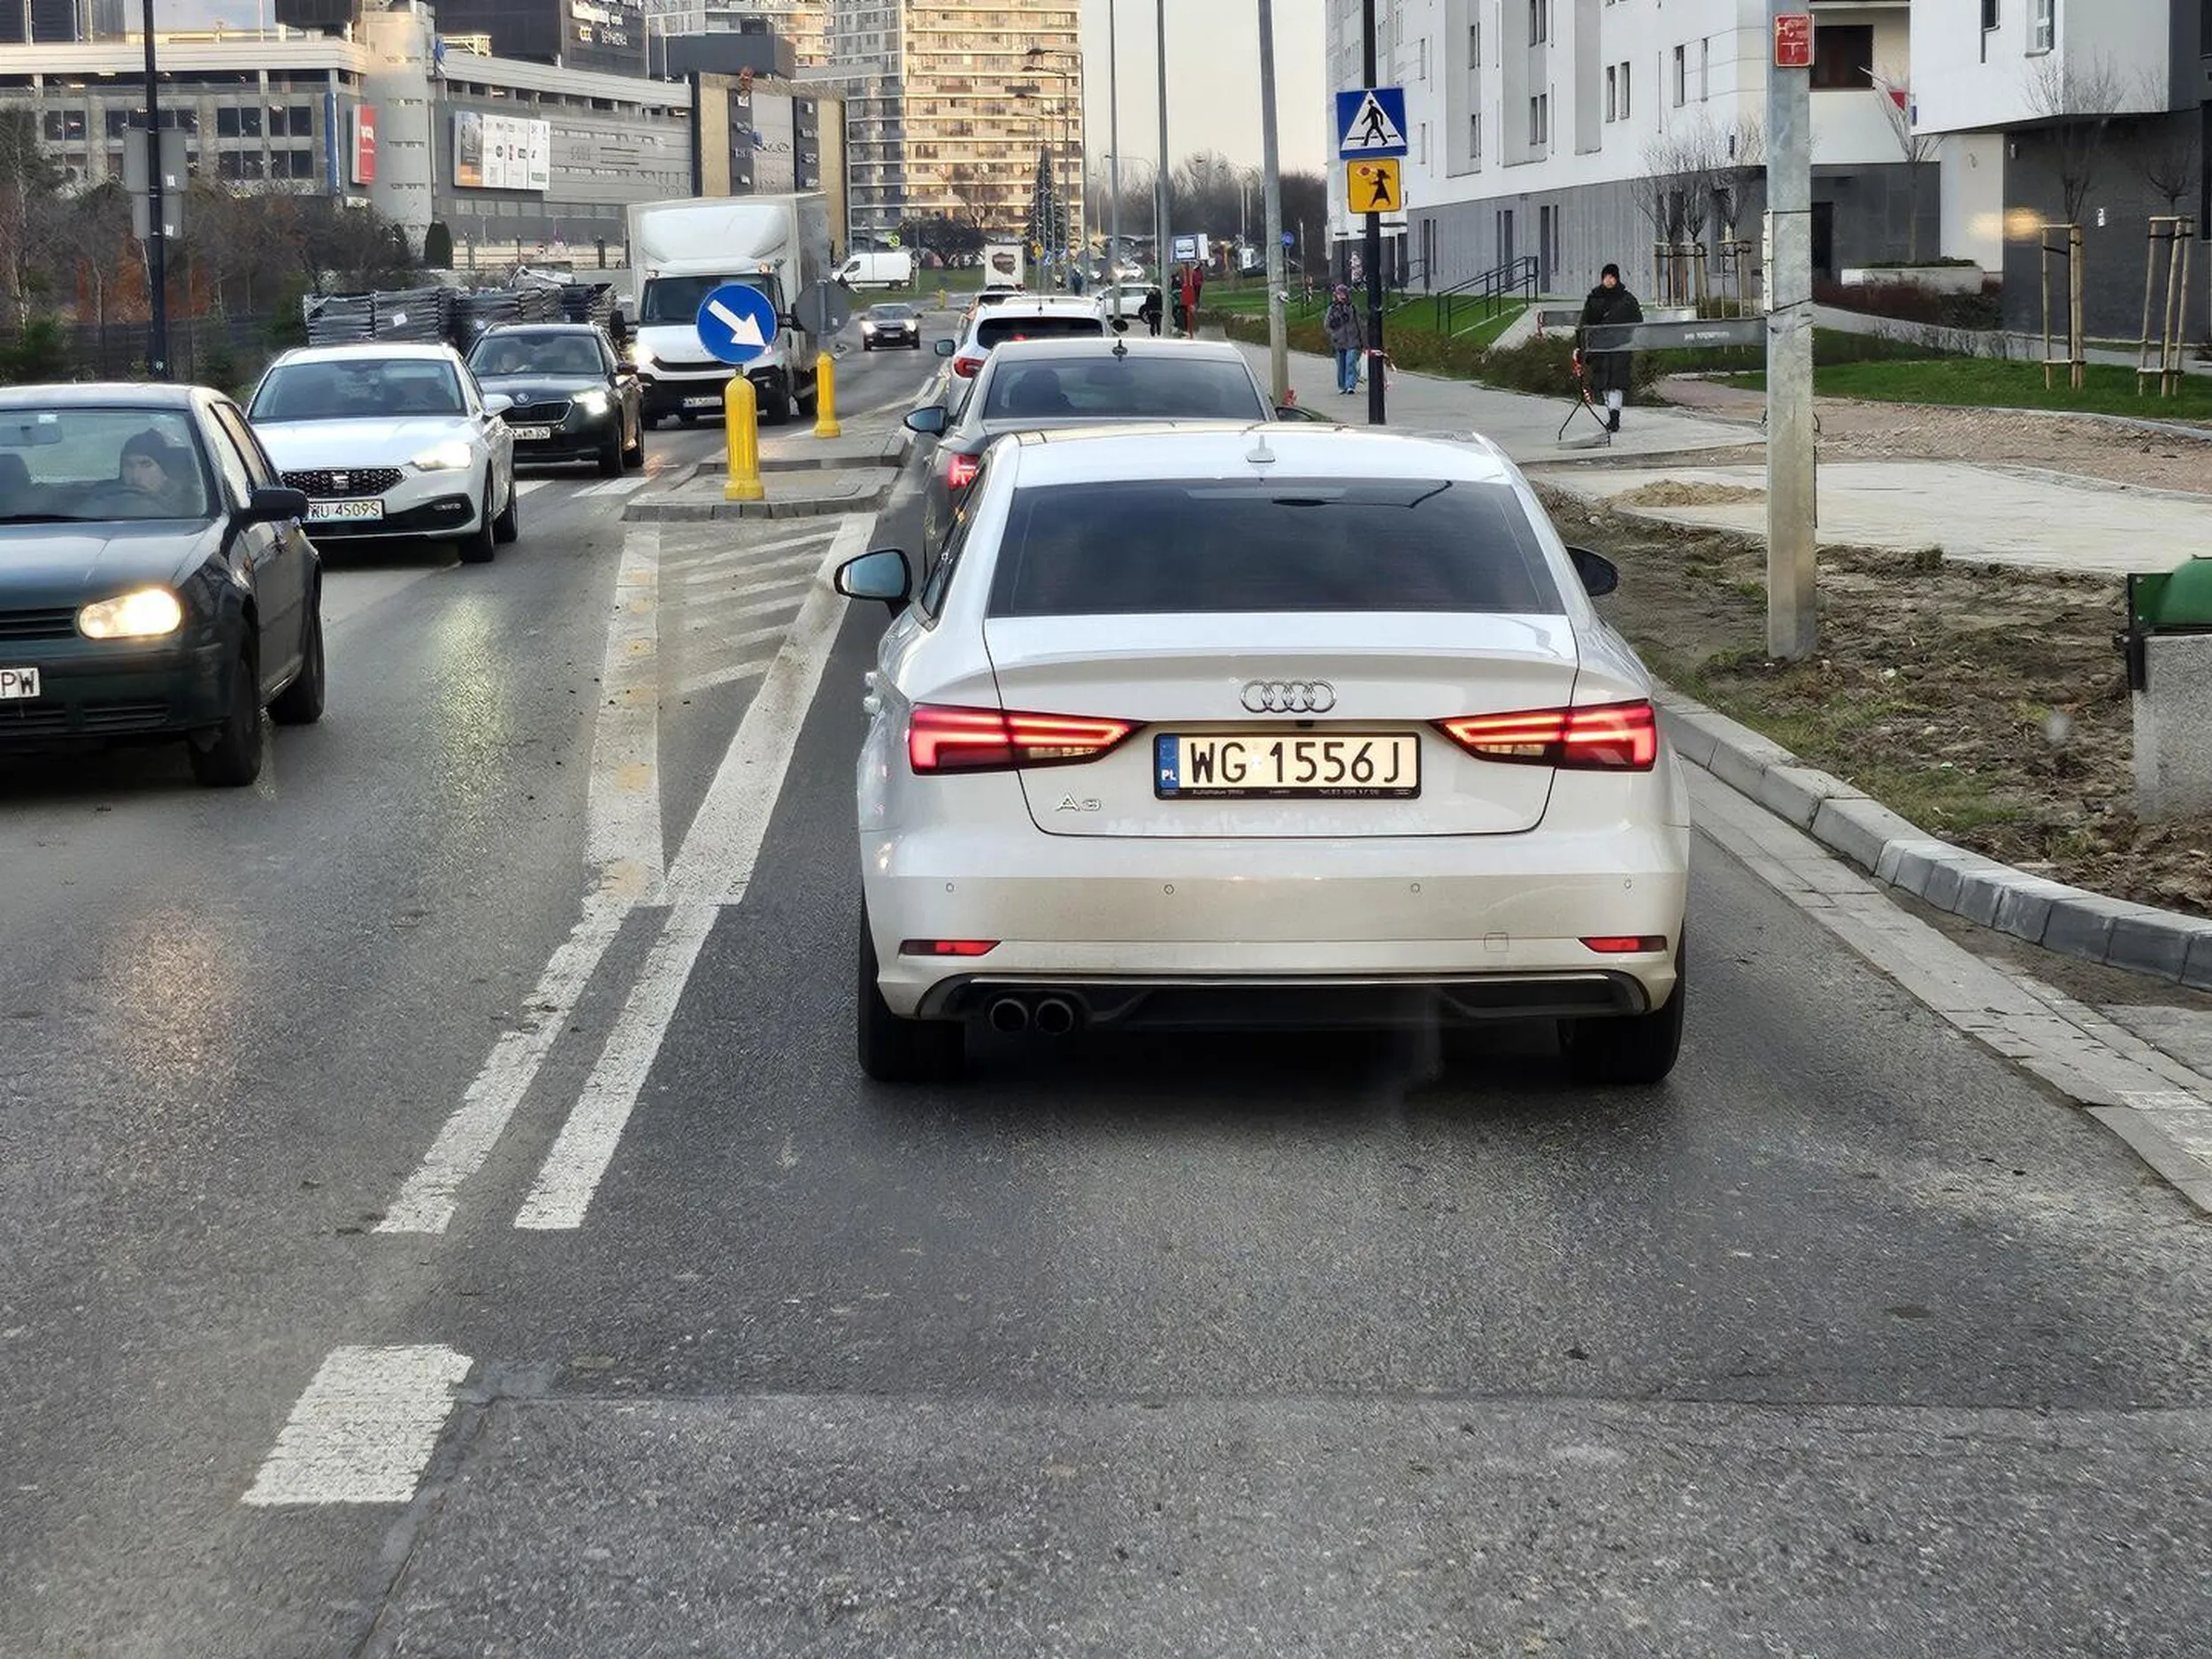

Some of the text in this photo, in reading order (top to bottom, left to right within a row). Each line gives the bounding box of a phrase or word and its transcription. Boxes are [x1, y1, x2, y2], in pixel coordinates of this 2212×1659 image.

[336, 502, 380, 517] 4509S
[1190, 741, 1400, 783] WG 1556J
[1161, 769, 1177, 780] PL
[1054, 793, 1102, 812] A3
